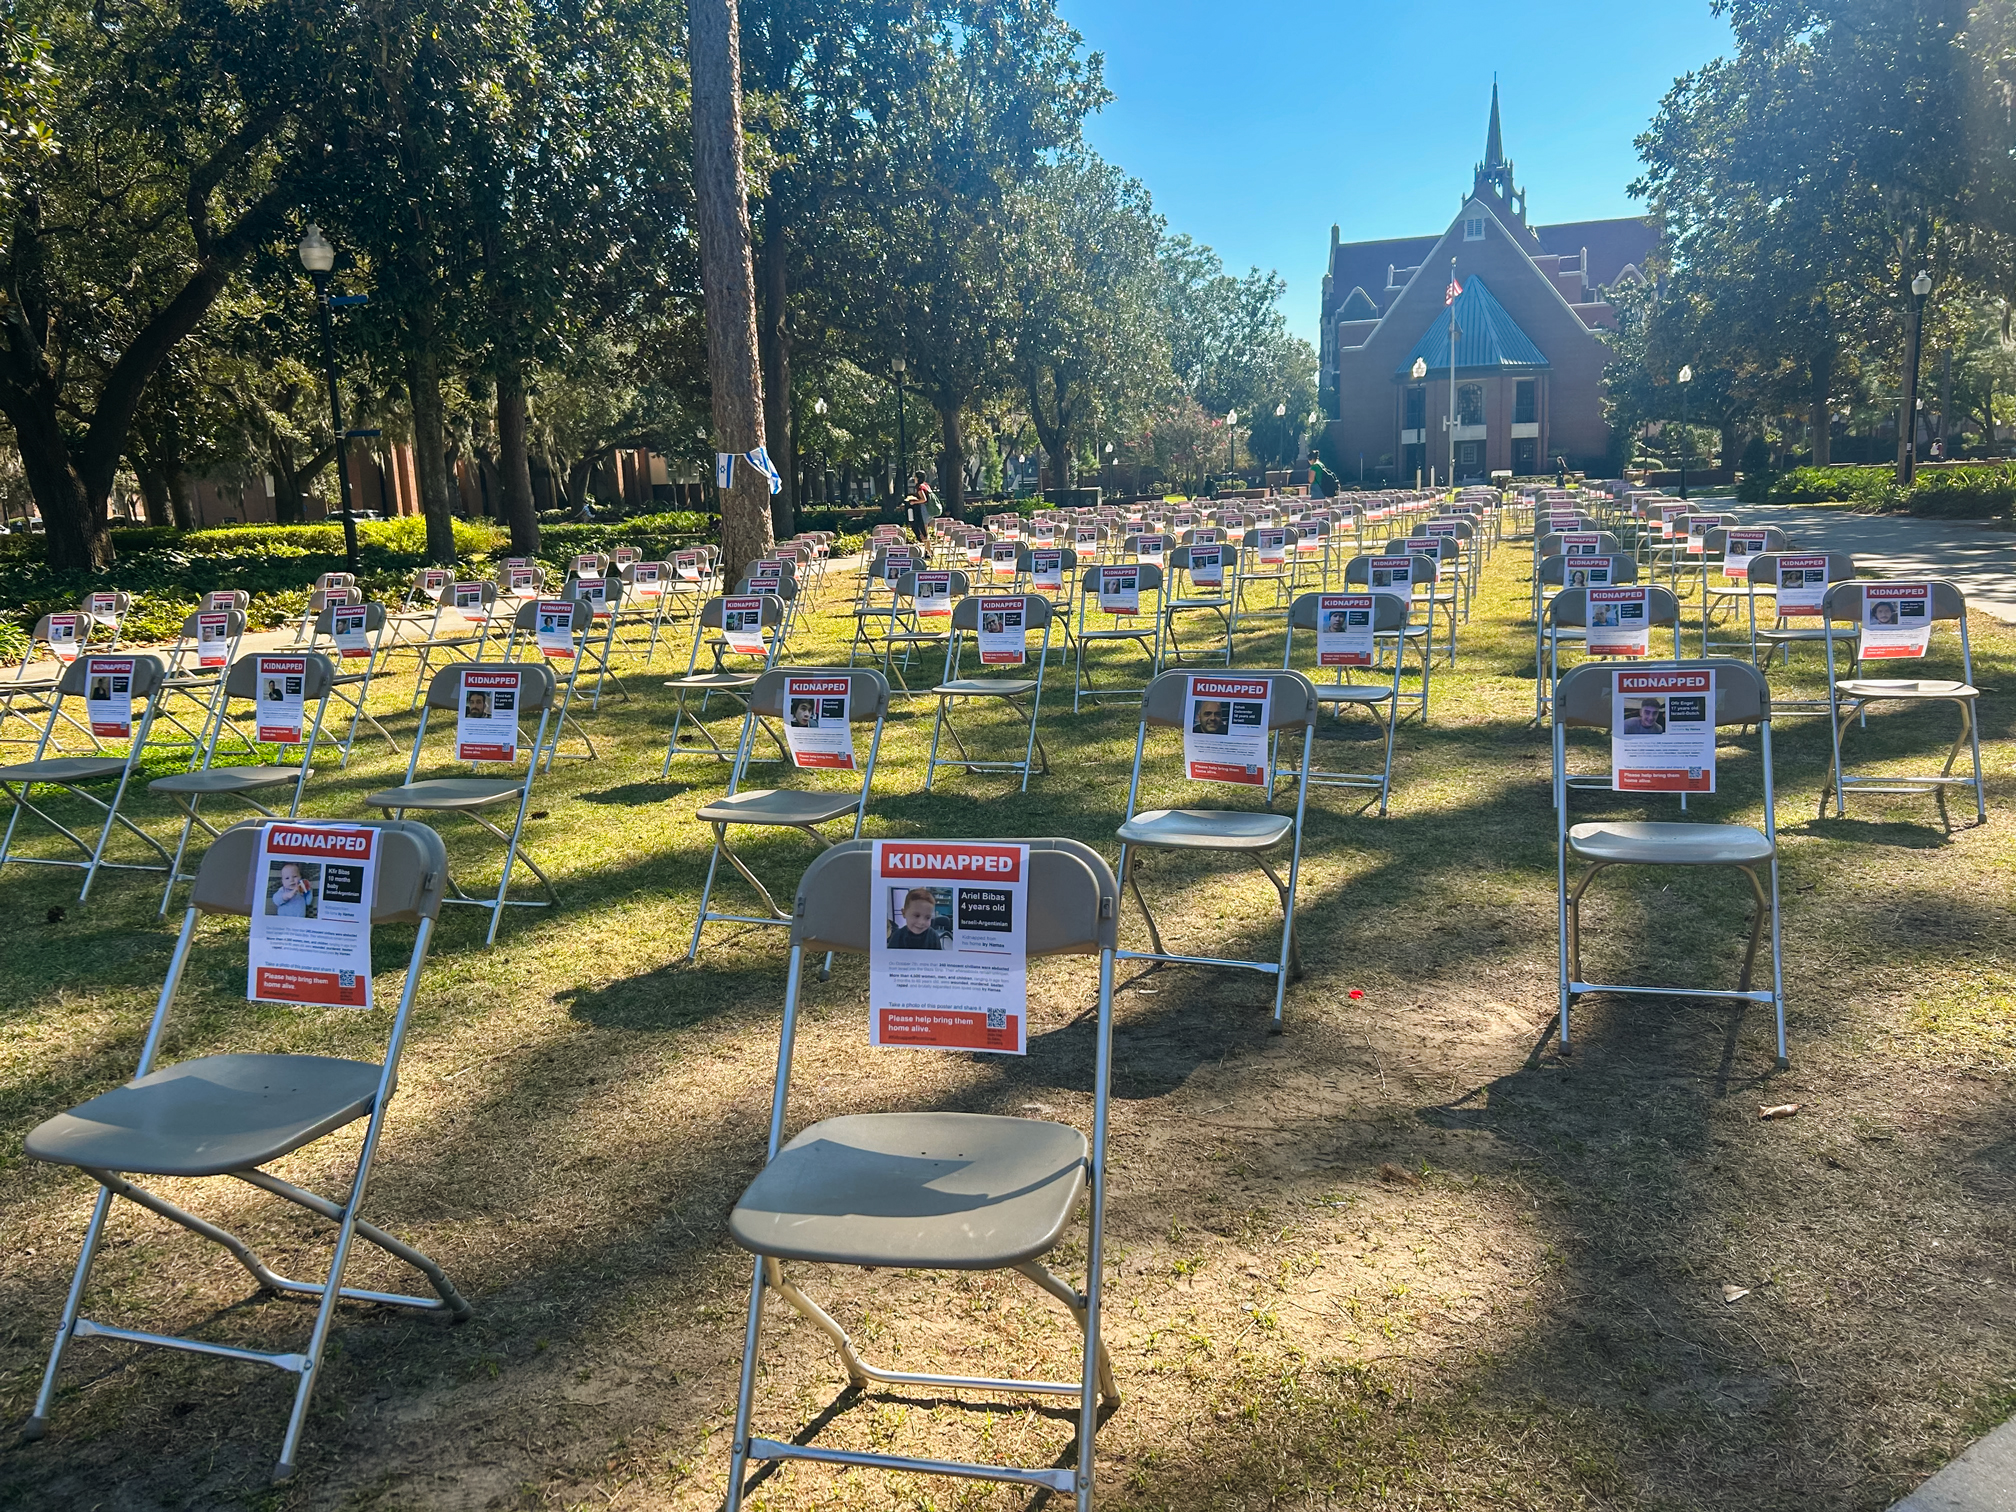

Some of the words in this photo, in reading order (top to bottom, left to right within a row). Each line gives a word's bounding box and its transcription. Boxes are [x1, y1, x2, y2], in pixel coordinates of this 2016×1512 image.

[1592, 591, 1643, 599] KIDNAPPED
[1870, 588, 1925, 596] KIDNAPPED
[263, 662, 303, 670] KIDNAPPED
[467, 676, 516, 684] KIDNAPPED
[1623, 677, 1706, 688] KIDNAPPED
[792, 683, 846, 691] KIDNAPPED
[1196, 683, 1264, 694] KIDNAPPED
[273, 832, 366, 851] KIDNAPPED
[888, 853, 1013, 872] KIDNAPPED
[961, 891, 980, 900] Ariel
[982, 892, 1006, 901] Bibas
[961, 902, 967, 910] 4
[967, 903, 991, 911] years
[961, 919, 1009, 927] Israeli-Argentinian
[264, 972, 284, 980] Please
[285, 974, 297, 982] help
[298, 976, 312, 984] bring
[888, 1014, 913, 1022] Please
[915, 1015, 932, 1023] help
[933, 1016, 953, 1025] bring
[954, 1017, 974, 1025] them
